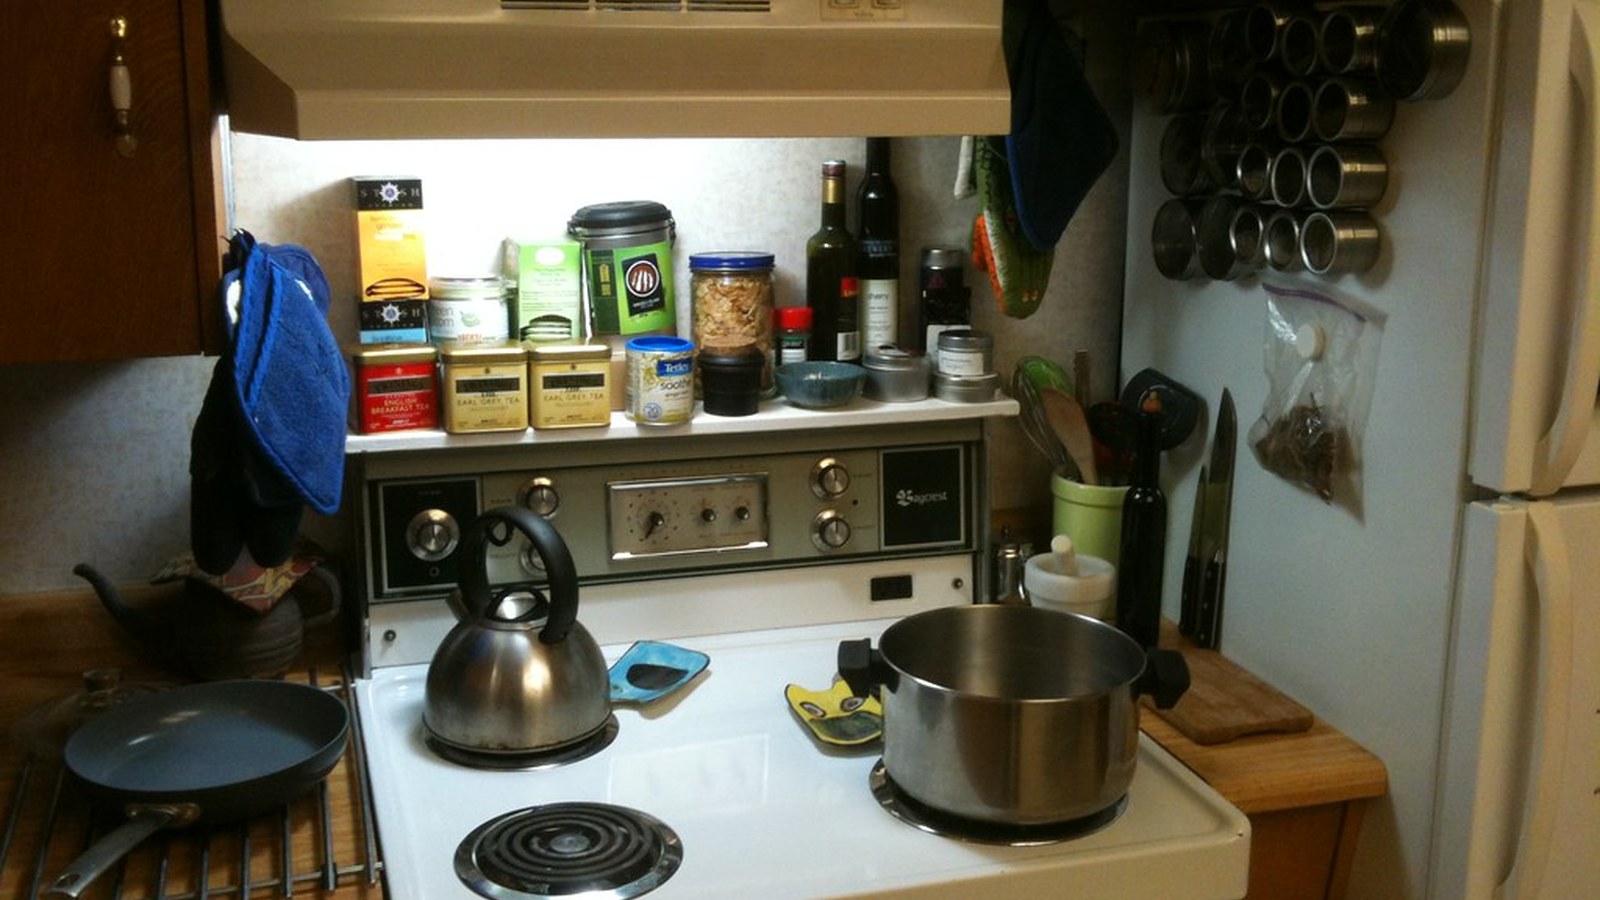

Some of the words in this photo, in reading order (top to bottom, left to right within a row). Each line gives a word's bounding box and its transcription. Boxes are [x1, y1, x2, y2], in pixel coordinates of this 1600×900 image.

[384, 397, 418, 407] ENGLISH
[480, 398, 501, 406] GREY
[543, 394, 563, 402] EARL
[566, 393, 587, 401] GREY
[590, 392, 604, 400] TEA
[371, 404, 413, 415] BREAKFAST
[415, 403, 430, 411] TEA
